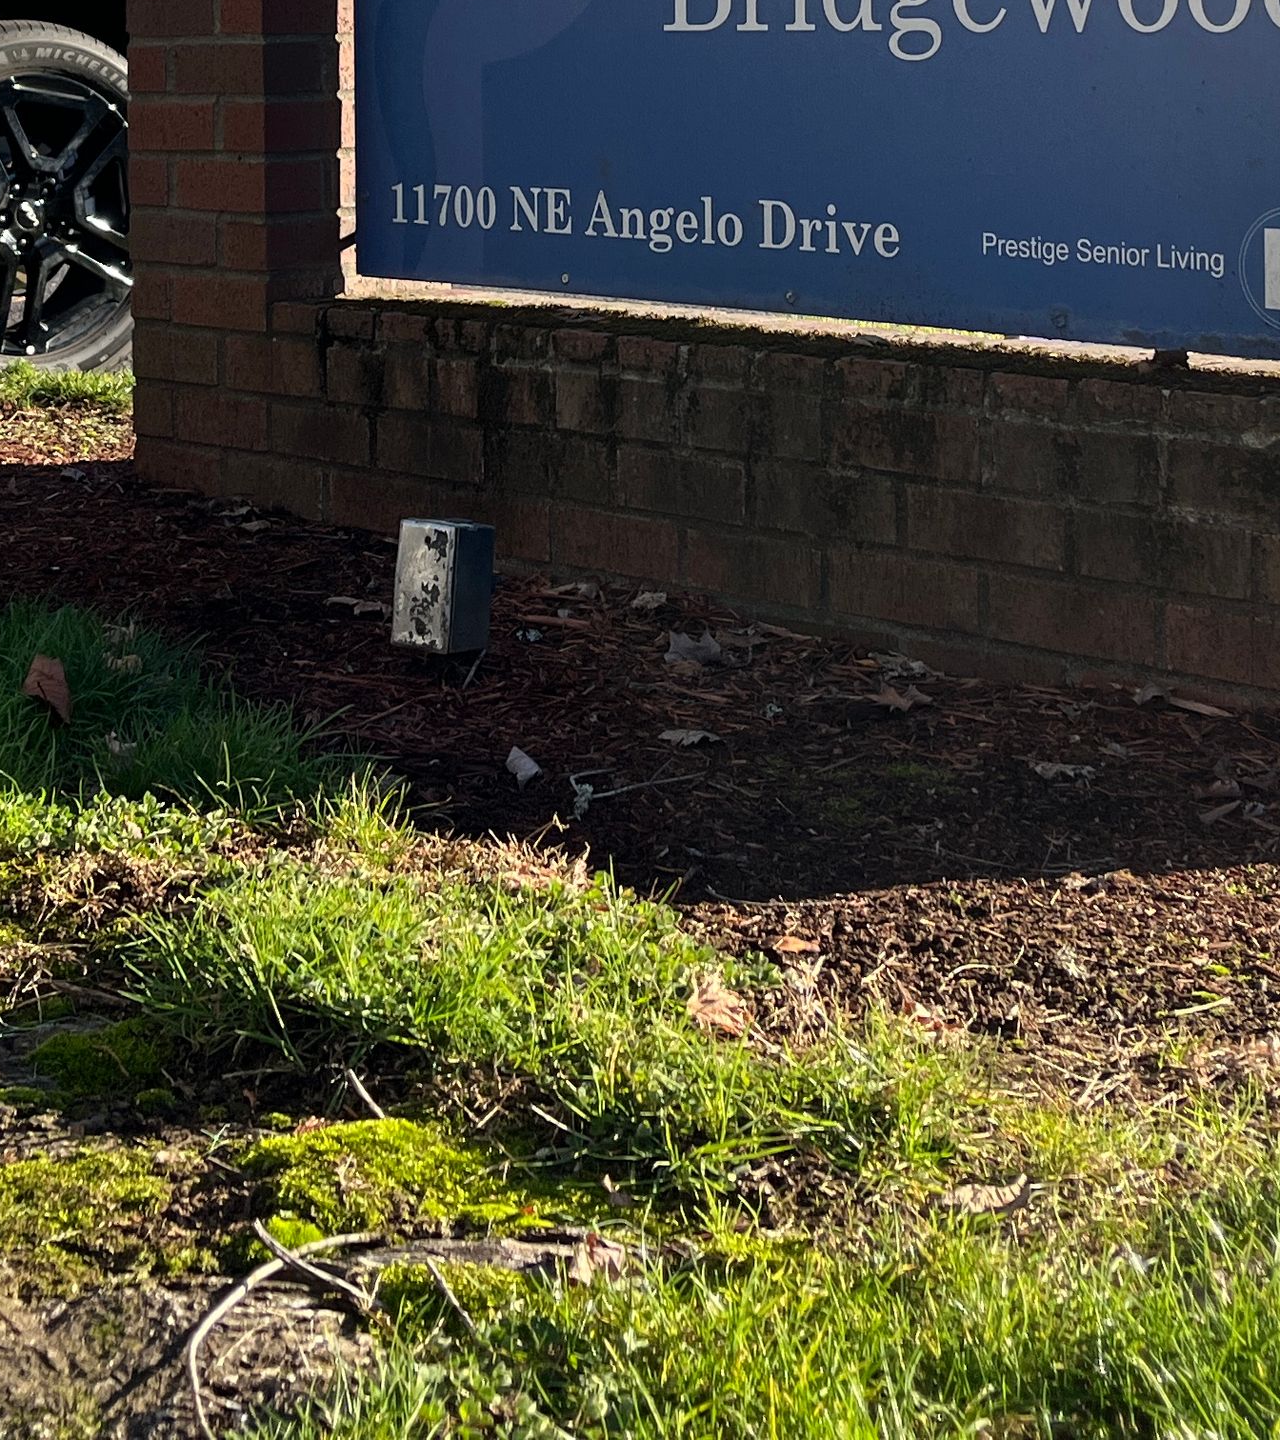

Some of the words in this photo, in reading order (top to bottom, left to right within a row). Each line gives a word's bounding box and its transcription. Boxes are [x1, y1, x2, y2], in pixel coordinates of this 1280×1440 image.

[390, 182, 497, 230] 11700
[508, 185, 573, 236] NE
[584, 189, 744, 253] Angelo
[758, 198, 901, 259] Drive
[981, 231, 1069, 266] Prestige
[1076, 237, 1151, 268] Senior
[1156, 243, 1226, 279] Living
